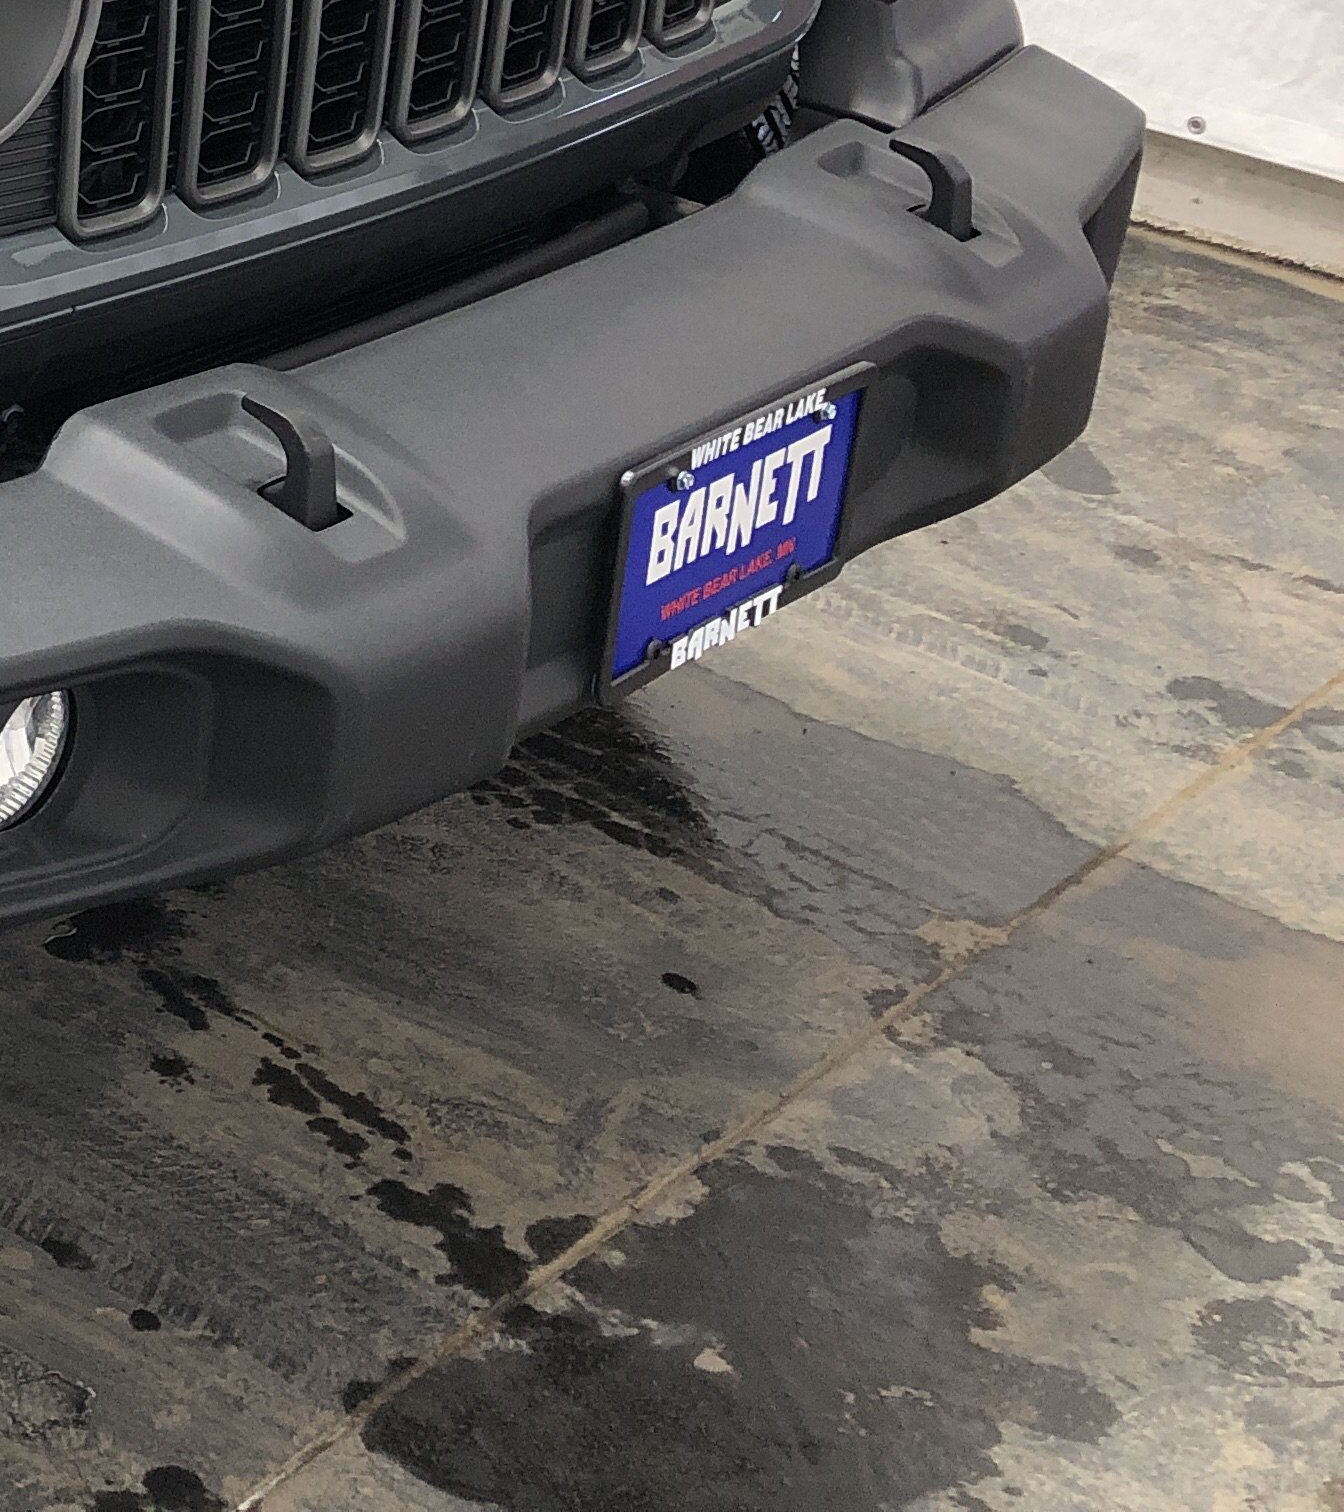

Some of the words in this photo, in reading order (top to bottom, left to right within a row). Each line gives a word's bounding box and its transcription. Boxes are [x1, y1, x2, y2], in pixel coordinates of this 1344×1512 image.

[691, 427, 743, 471] WHITE
[742, 407, 785, 446] BEAR
[785, 387, 827, 426] LAKE
[645, 423, 833, 587] BARNETT
[660, 587, 701, 621] WHITE
[703, 567, 737, 600] BEAR
[670, 584, 784, 671] BARNETT
